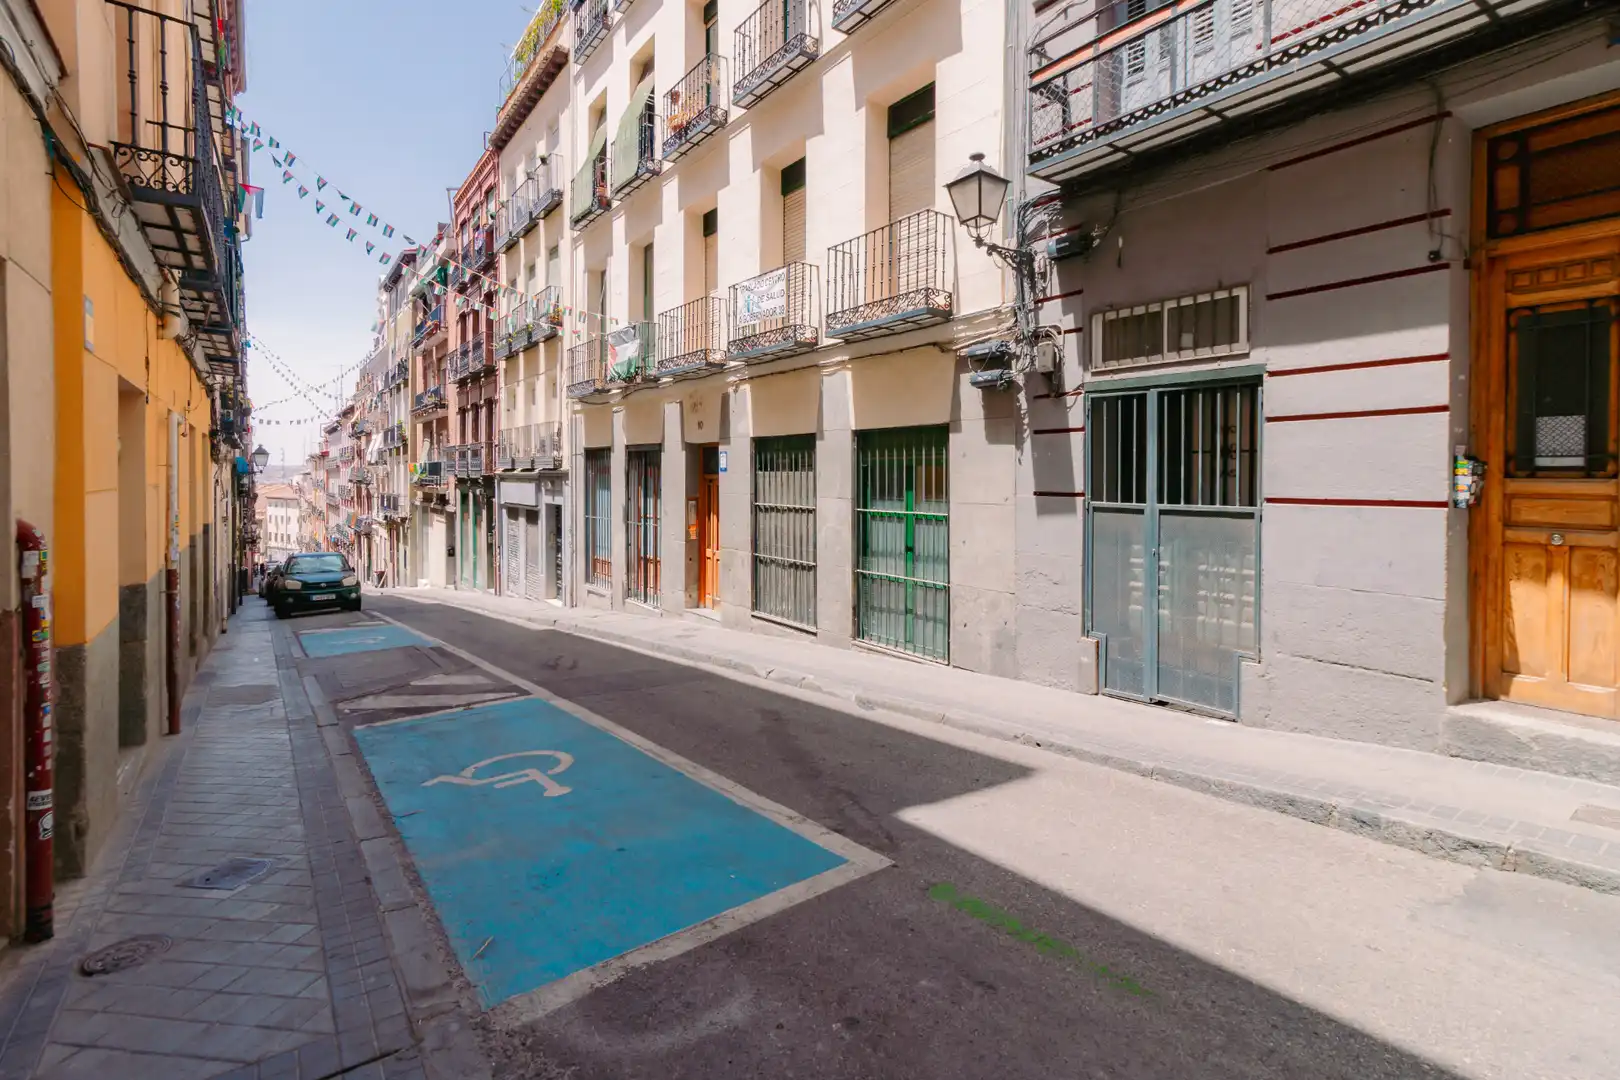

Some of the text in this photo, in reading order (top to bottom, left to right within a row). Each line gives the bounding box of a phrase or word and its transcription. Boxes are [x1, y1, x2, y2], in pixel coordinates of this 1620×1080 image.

[765, 272, 785, 287] CENTRO
[757, 289, 785, 304] DE SALUD
[697, 420, 704, 431] 10
